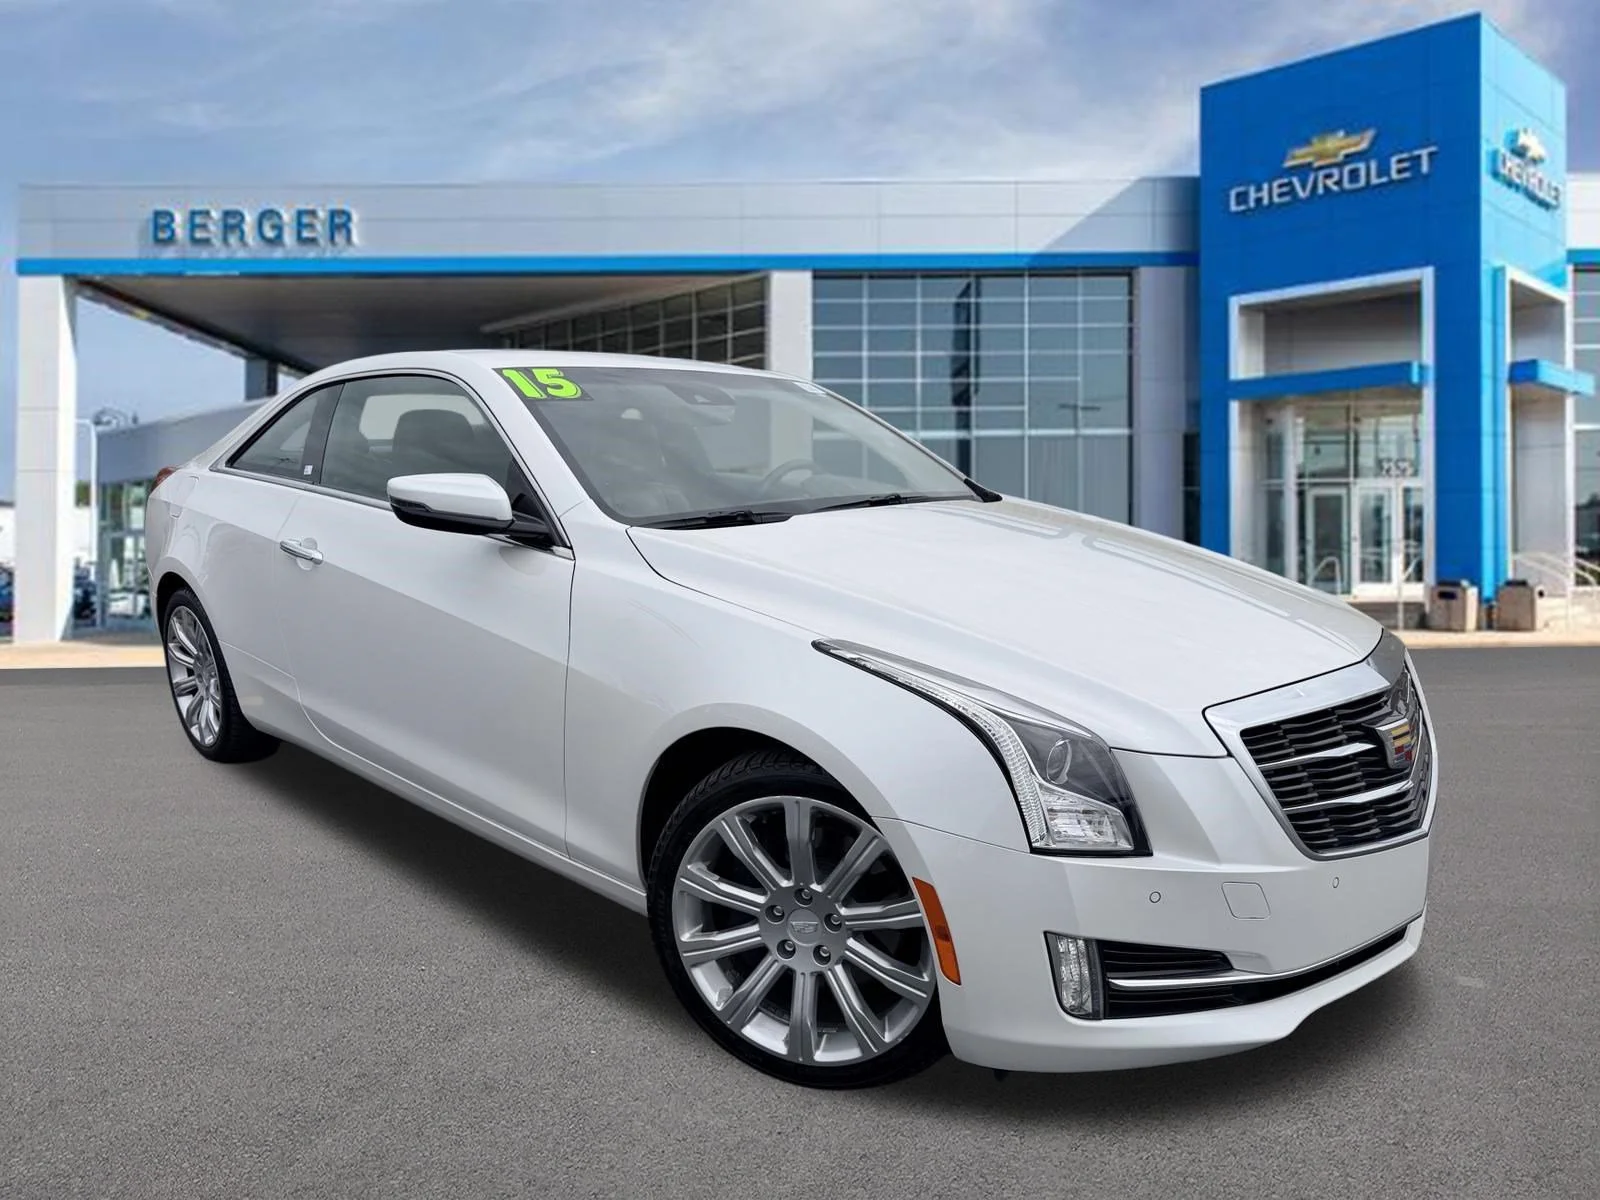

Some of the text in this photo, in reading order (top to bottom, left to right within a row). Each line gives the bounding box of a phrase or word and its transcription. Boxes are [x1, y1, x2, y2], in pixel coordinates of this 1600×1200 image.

[1229, 146, 1437, 213] CHEVROLET
[152, 208, 357, 246] BERGER
[502, 367, 583, 399] 15
